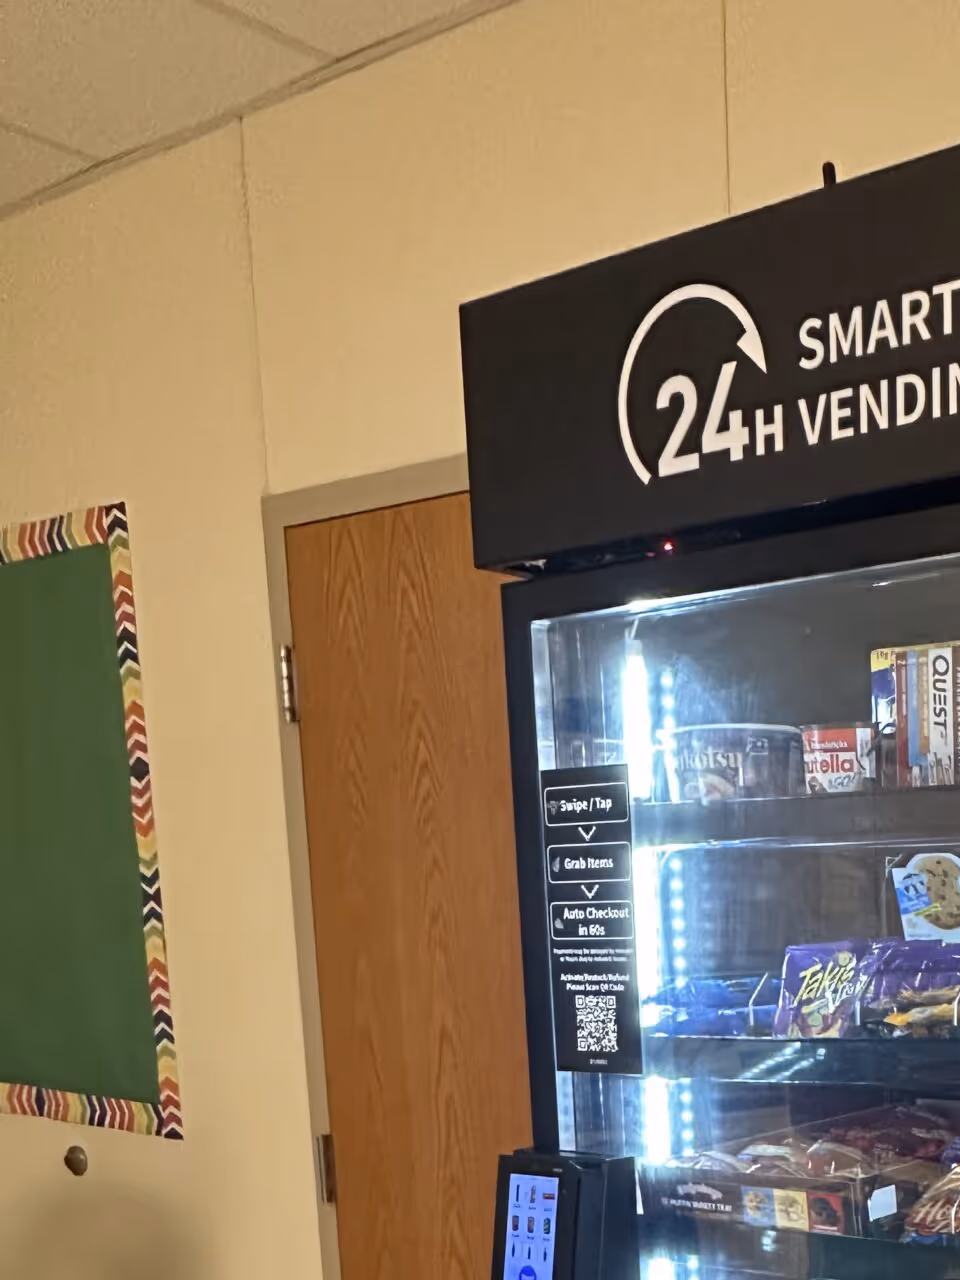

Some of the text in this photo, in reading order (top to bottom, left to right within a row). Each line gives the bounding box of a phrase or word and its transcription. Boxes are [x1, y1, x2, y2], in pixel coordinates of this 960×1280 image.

[932, 654, 950, 729] QUEST
[560, 798, 588, 813] Swipe
[594, 797, 612, 812] Tap
[564, 857, 614, 869] Grab Items
[563, 907, 630, 920] Auto Checkout
[578, 924, 605, 936] in 60s
[793, 961, 856, 1008] Takis
